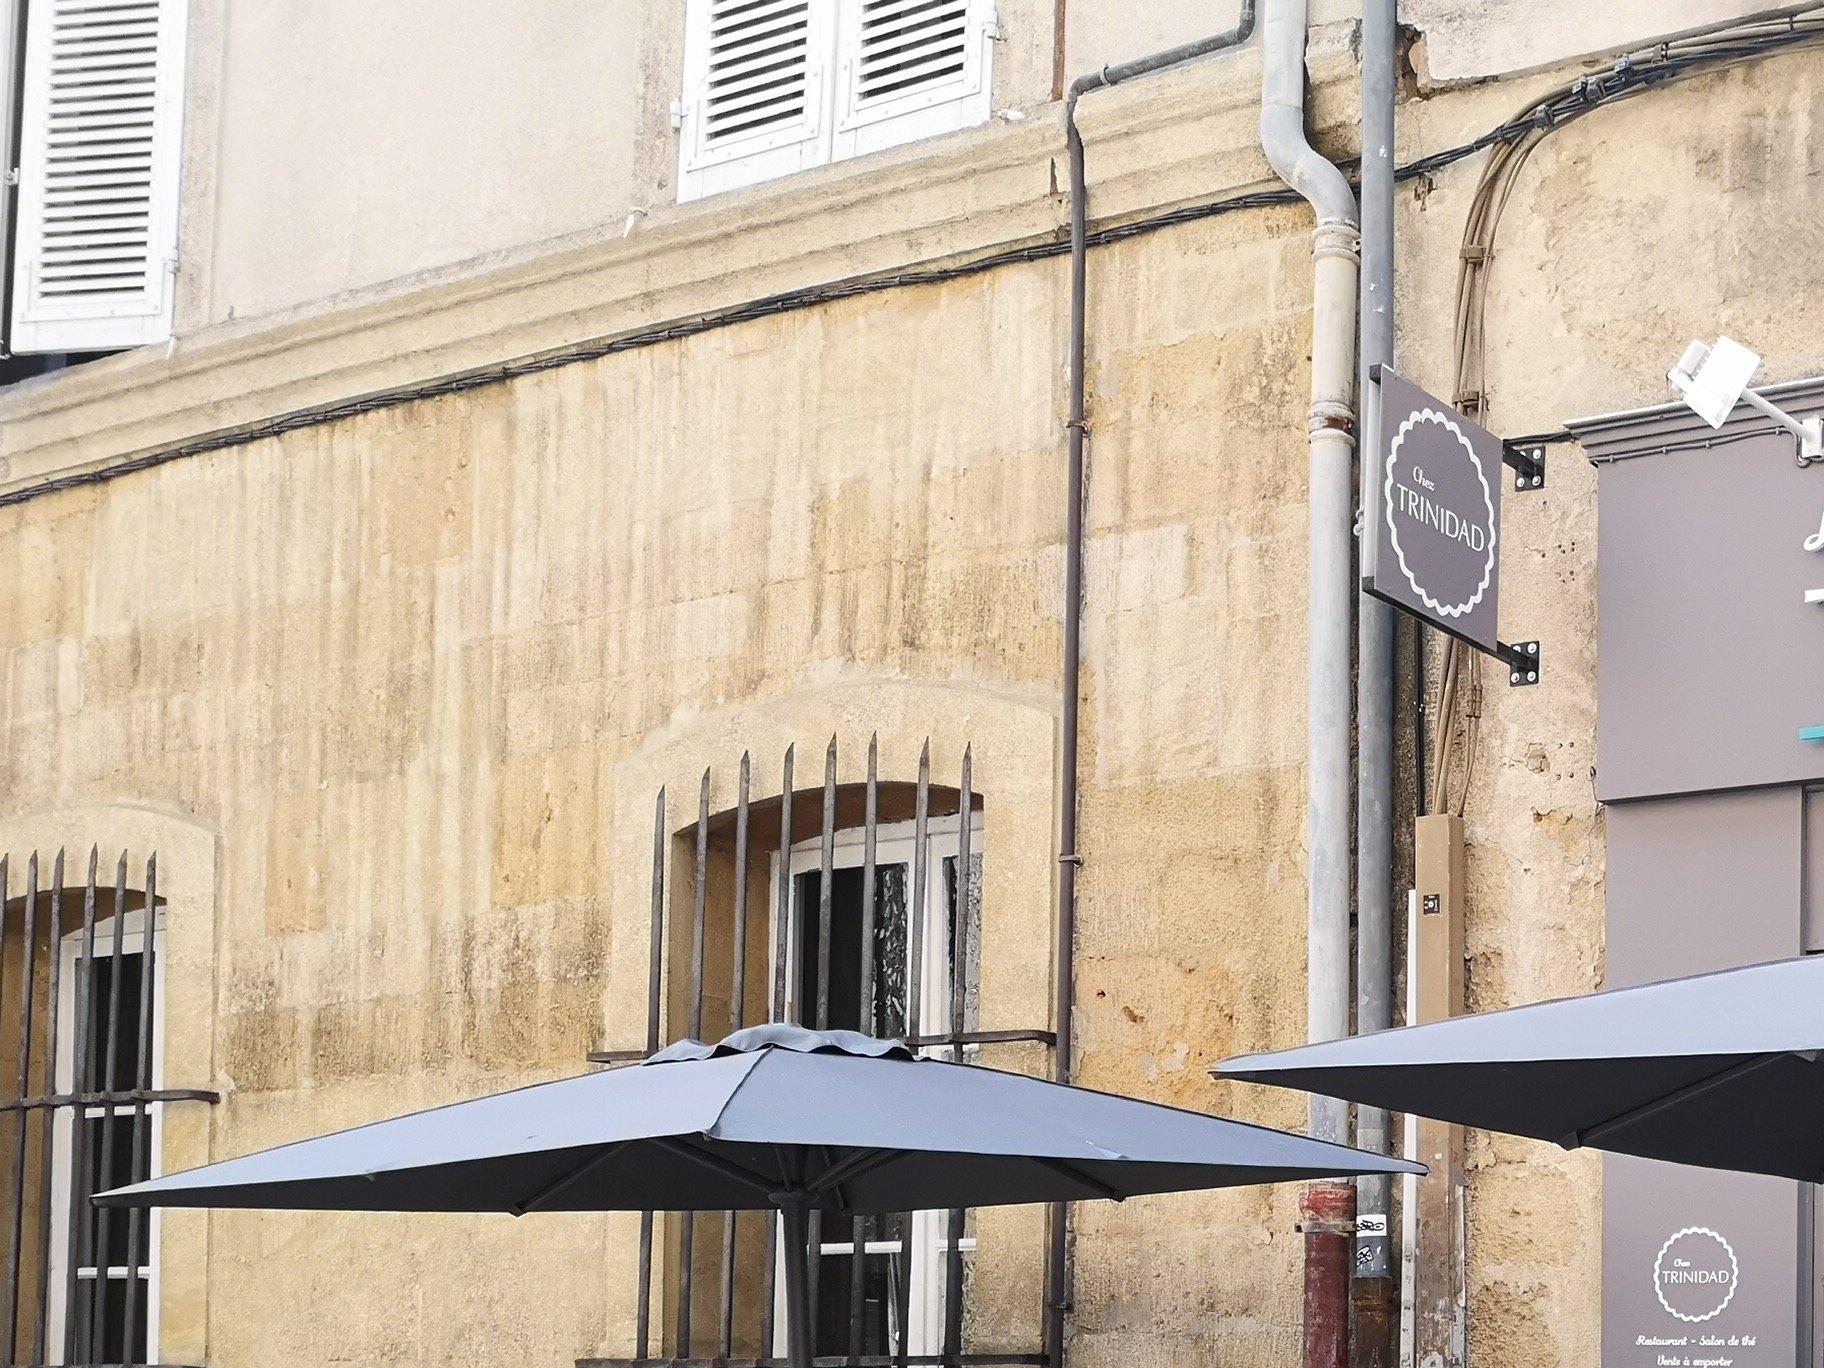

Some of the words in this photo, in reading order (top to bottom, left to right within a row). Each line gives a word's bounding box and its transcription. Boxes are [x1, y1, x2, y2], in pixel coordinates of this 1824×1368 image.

[1412, 465, 1436, 492] Chez
[1396, 483, 1485, 552] TRINIDAD
[1661, 1270, 1730, 1284] TRINIDAD
[1635, 1334, 1688, 1346] Restaurant
[1698, 1334, 1726, 1346] Salon
[1727, 1334, 1740, 1346] de
[1741, 1334, 1757, 1347] thé
[1656, 1354, 1681, 1367] Vente
